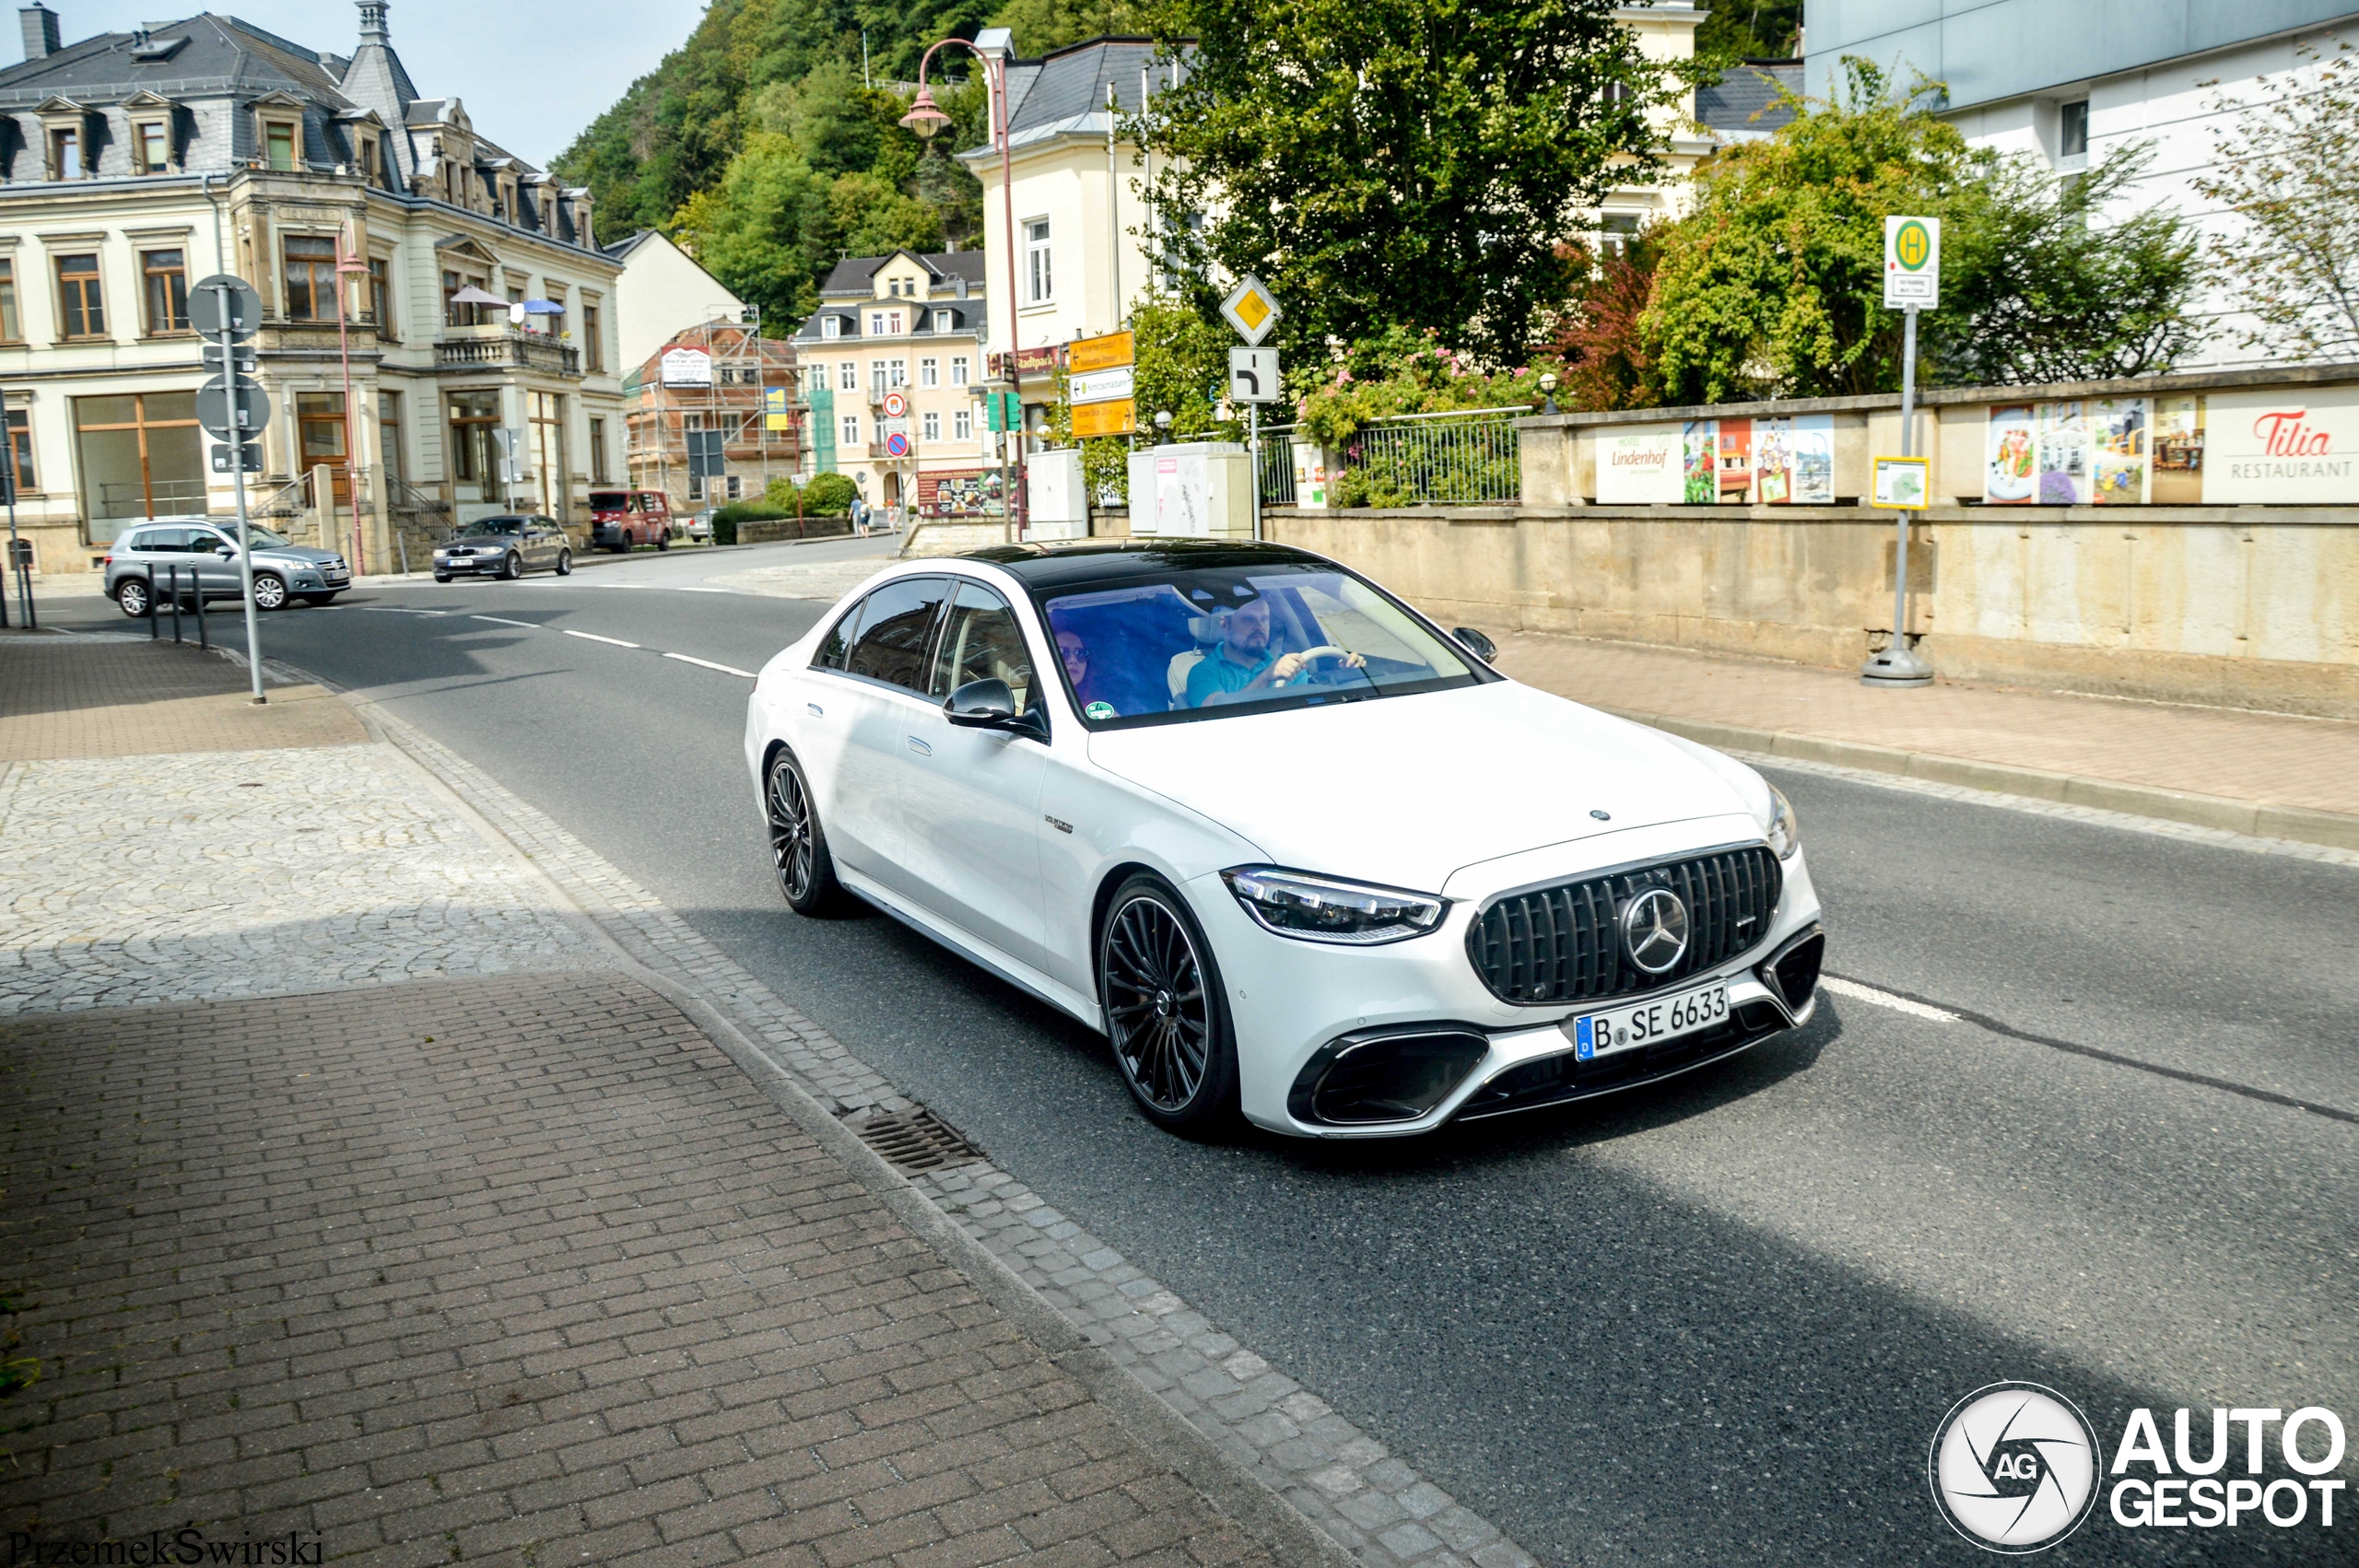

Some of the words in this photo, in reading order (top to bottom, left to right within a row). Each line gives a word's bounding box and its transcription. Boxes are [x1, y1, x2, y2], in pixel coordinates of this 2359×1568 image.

[1907, 231, 1919, 260] H
[1618, 437, 1639, 446] HOTEL
[2253, 409, 2332, 456] Tilia
[1612, 449, 1669, 469] Lindenhof
[2231, 462, 2352, 479] RESTAURANT
[1594, 1018, 1612, 1050] B
[1631, 1005, 1664, 1041] SE
[1671, 987, 1725, 1030] 6633
[1581, 1042, 1590, 1052] D
